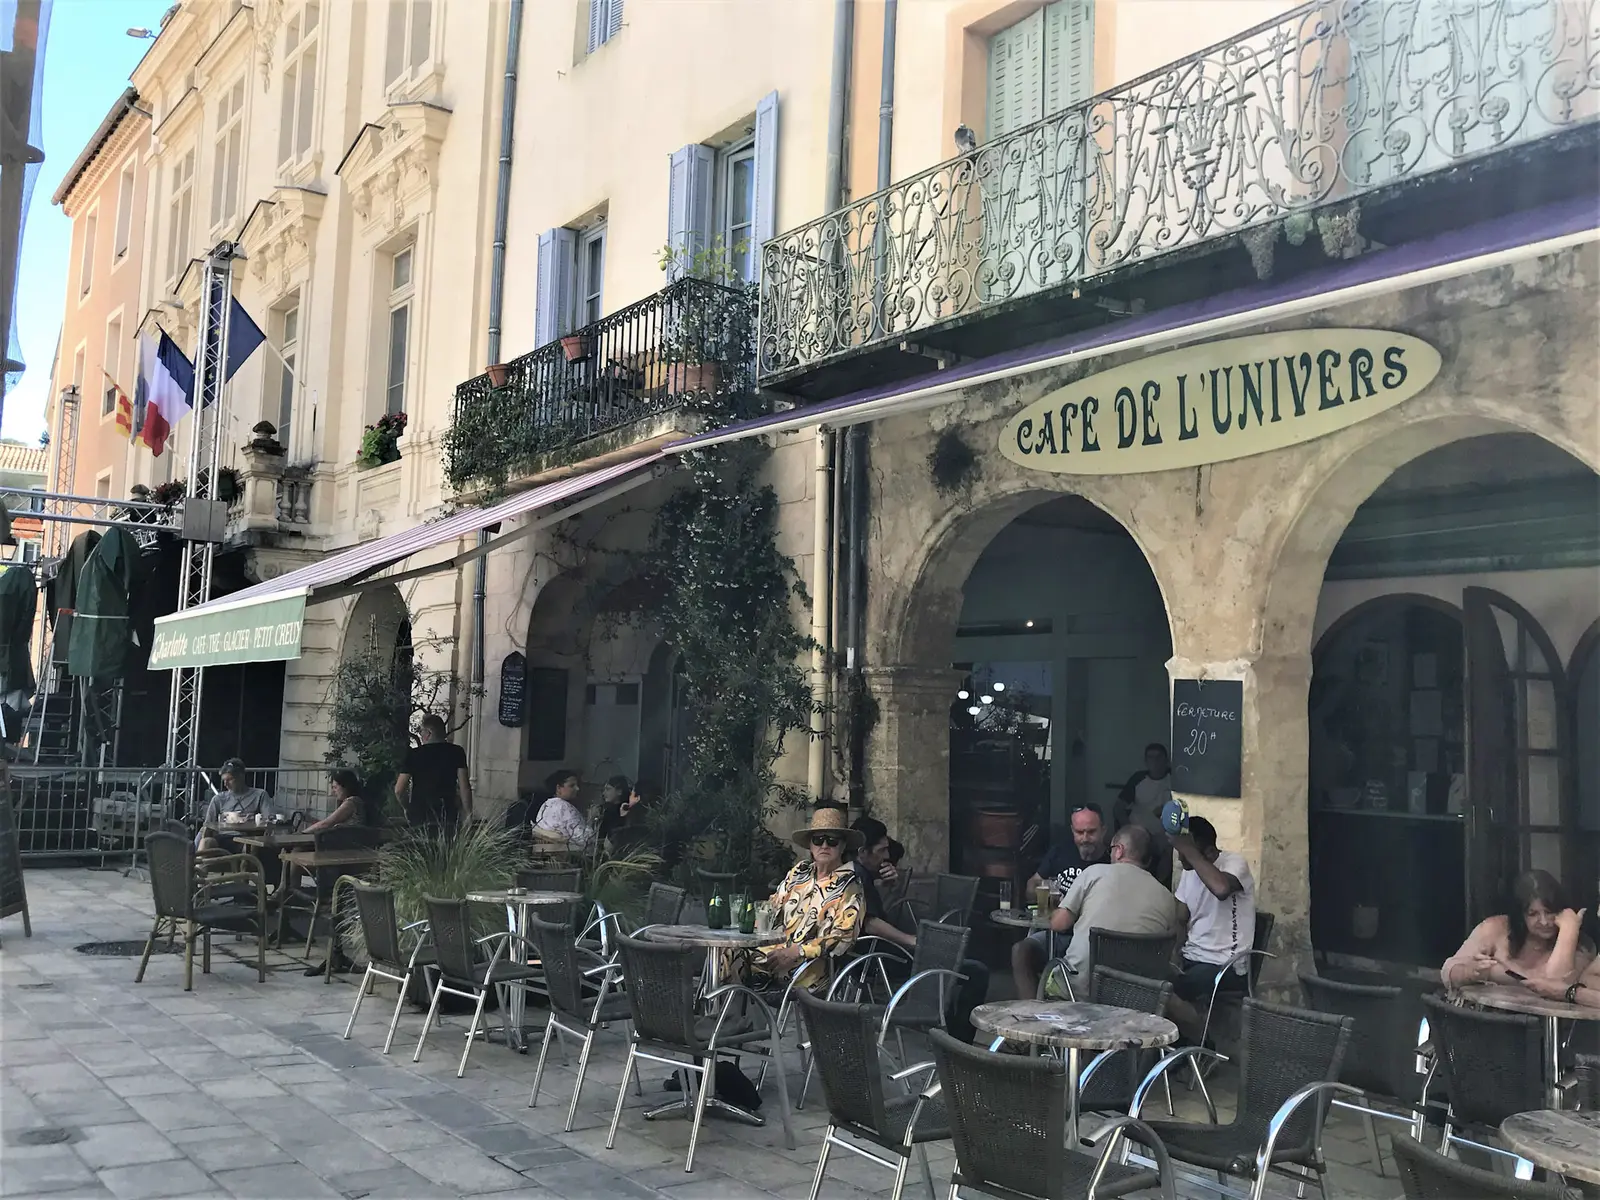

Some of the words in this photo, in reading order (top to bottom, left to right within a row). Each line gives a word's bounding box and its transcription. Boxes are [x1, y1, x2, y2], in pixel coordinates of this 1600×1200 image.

[1017, 396, 1101, 455] CAFE
[1114, 380, 1163, 449] DE
[1177, 346, 1409, 441] L'UNIVERS
[152, 631, 188, 664] Charlotte
[223, 628, 250, 651] GLACIER
[253, 625, 274, 648] PETIT
[1177, 702, 1236, 725] FERMETURE
